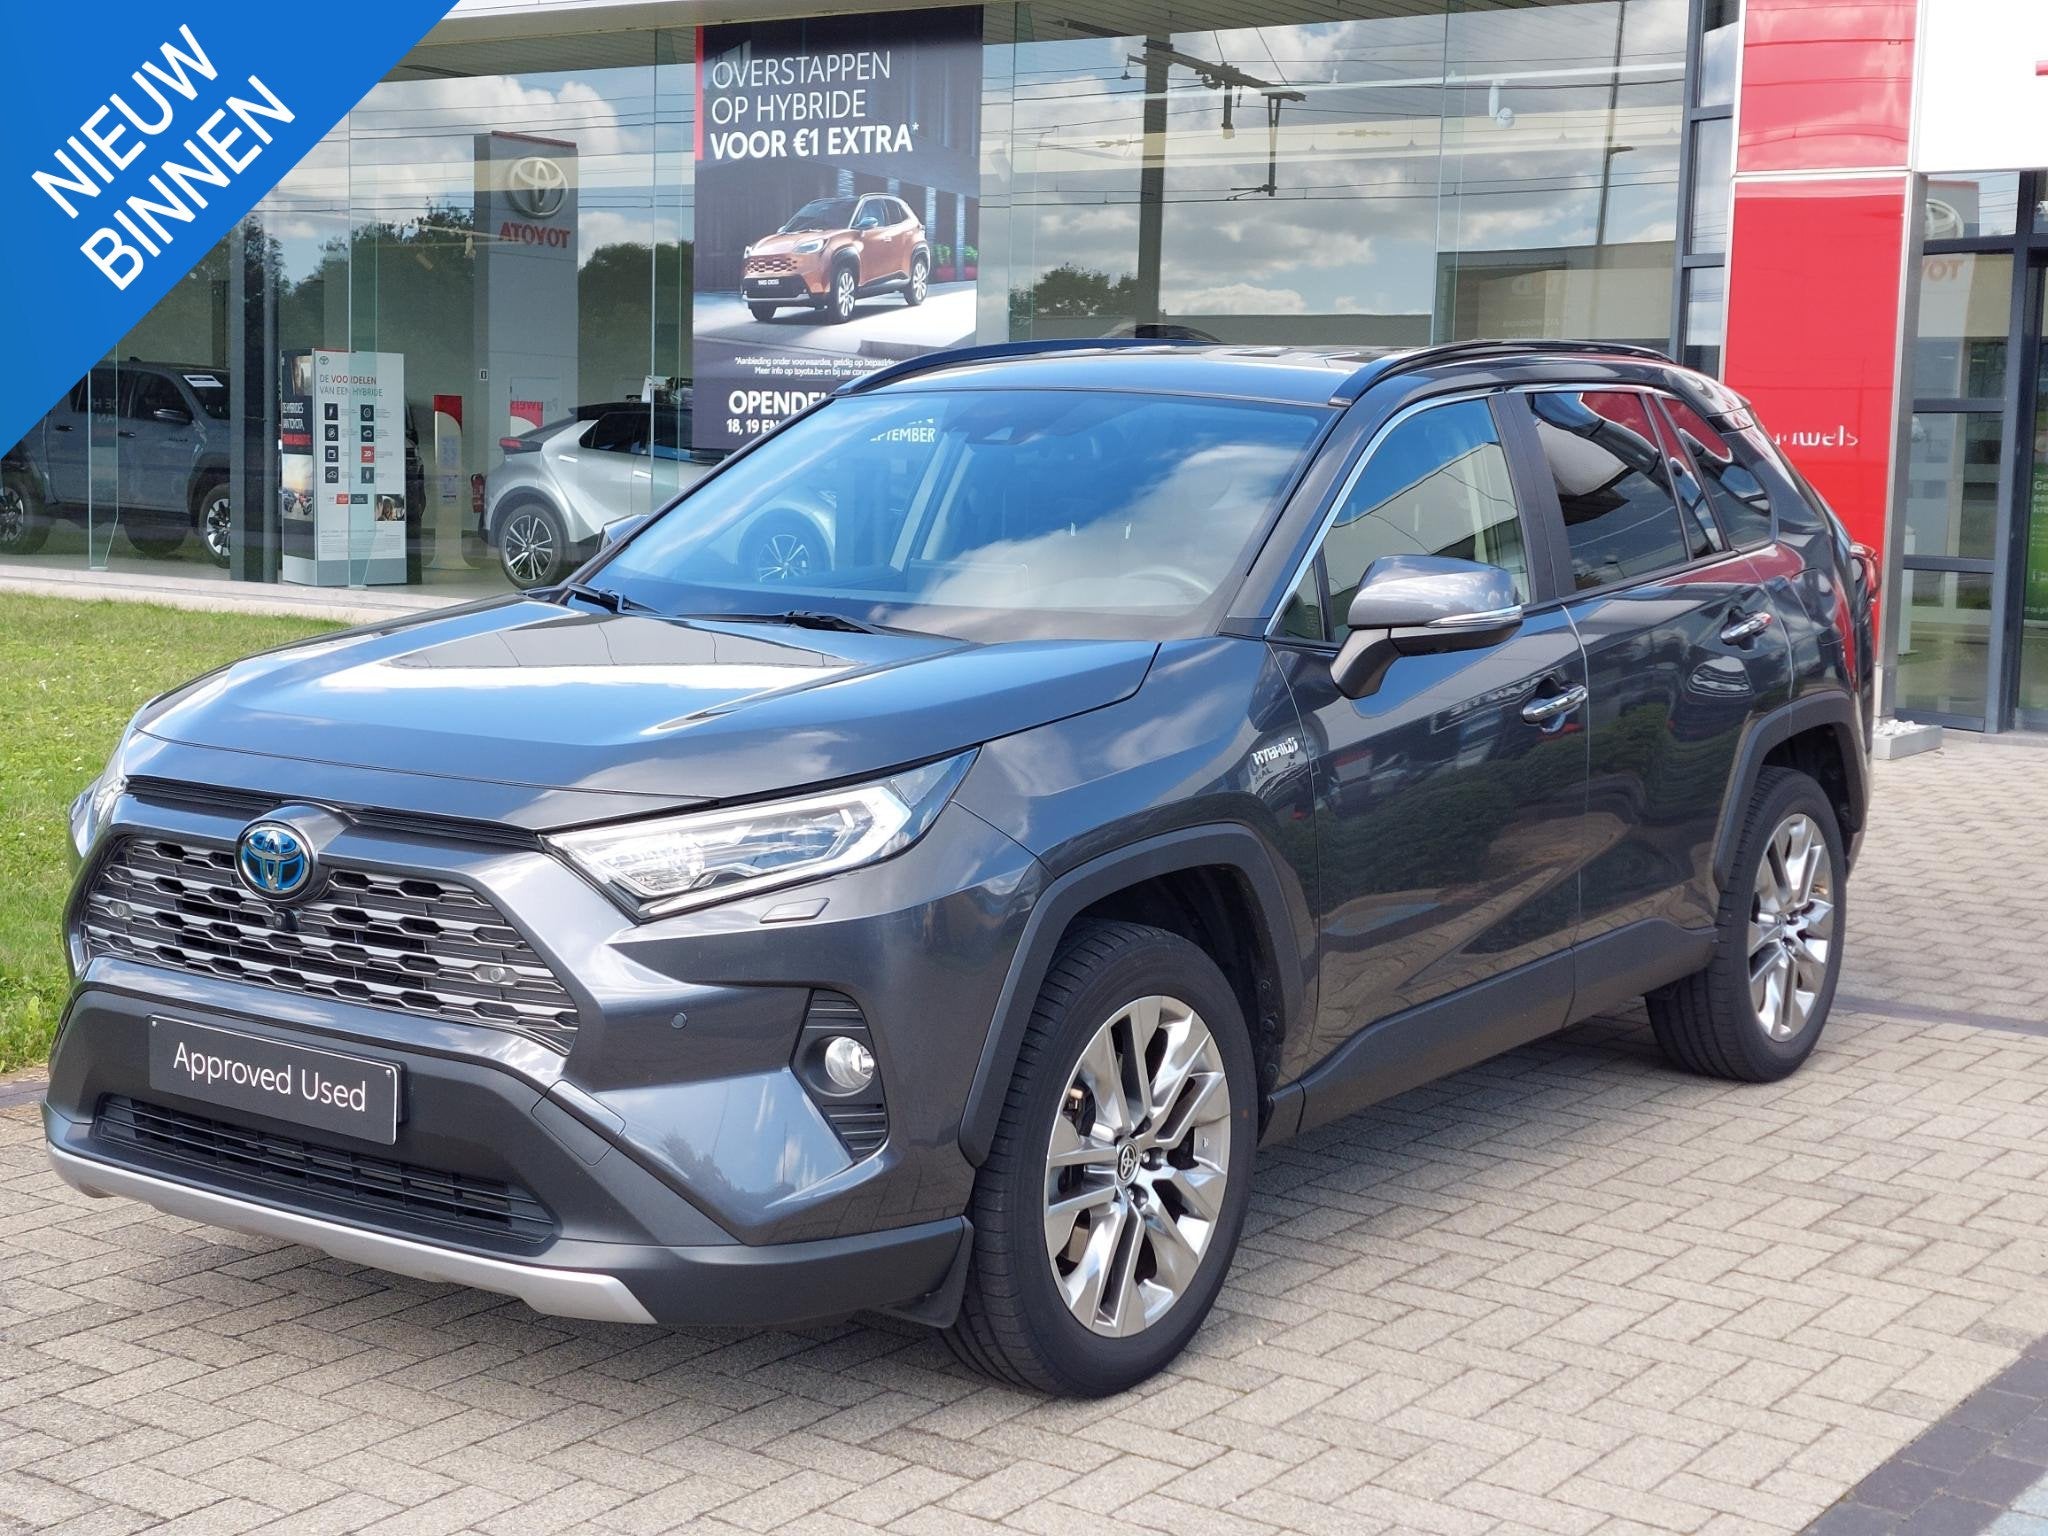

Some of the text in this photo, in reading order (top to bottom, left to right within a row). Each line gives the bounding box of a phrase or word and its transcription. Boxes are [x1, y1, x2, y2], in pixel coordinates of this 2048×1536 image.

[712, 51, 891, 89] OVERSTAPPEN
[711, 89, 866, 124] OP HYBRIDE
[710, 130, 787, 159] VOOR
[793, 128, 819, 157] €1
[794, 368, 823, 377] toyota.be
[726, 418, 743, 435] 18,
[746, 419, 760, 434] 19
[173, 1041, 366, 1113] Approved Used
